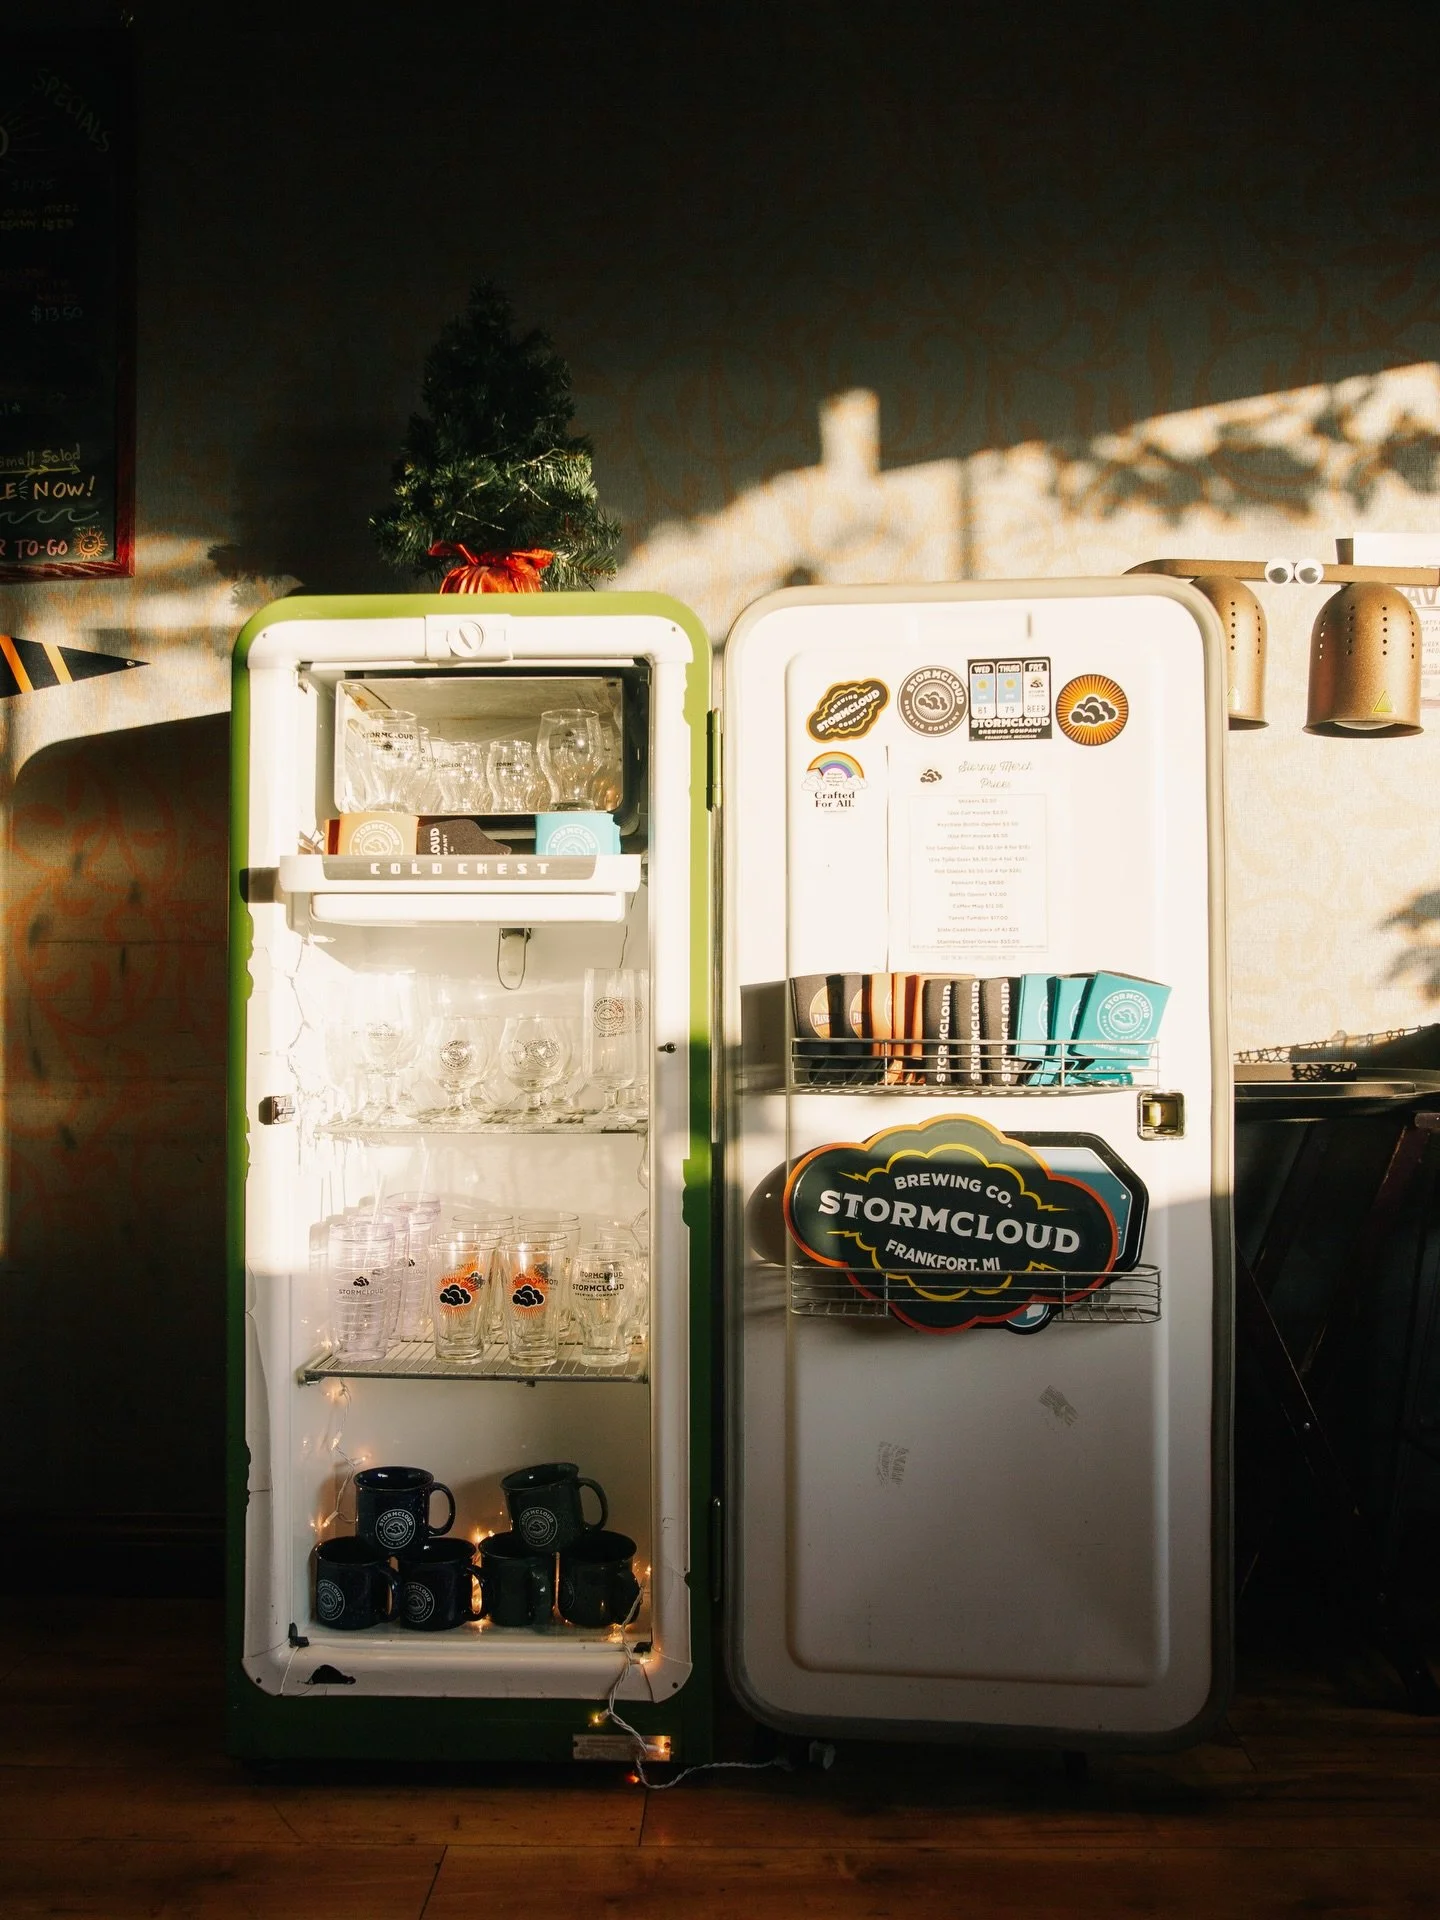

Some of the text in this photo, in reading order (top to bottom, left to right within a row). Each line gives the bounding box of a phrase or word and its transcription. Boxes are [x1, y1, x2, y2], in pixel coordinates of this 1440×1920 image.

[33, 475, 96, 500] NOW!
[14, 538, 69, 560] TO-GO
[905, 669, 965, 705] STORMCLOUD
[816, 689, 880, 733] STORMCLOUD
[830, 693, 858, 713] BREWING
[838, 707, 867, 728] COMPANY
[903, 699, 960, 732] BREWING COMPANY
[970, 717, 1050, 729] STORMCLOUD
[814, 791, 855, 800] Crafted
[815, 799, 855, 808] For All.
[371, 863, 550, 875] COLD CHEST
[1104, 992, 1150, 1019] STORMCLOUD
[936, 984, 952, 1083] STORMCLOUD
[970, 981, 980, 1081] STORMCLOUD
[1000, 982, 1011, 1083] STORMCLOUD
[894, 1173, 1013, 1209] BREWING CO.
[817, 1188, 1081, 1254] STORMCLOUD
[982, 1256, 1001, 1271] MI
[338, 1287, 384, 1296] STORMCLOUD
[572, 1283, 625, 1292] STORMCLOUD
[379, 1511, 413, 1527] STORMCLOUD
